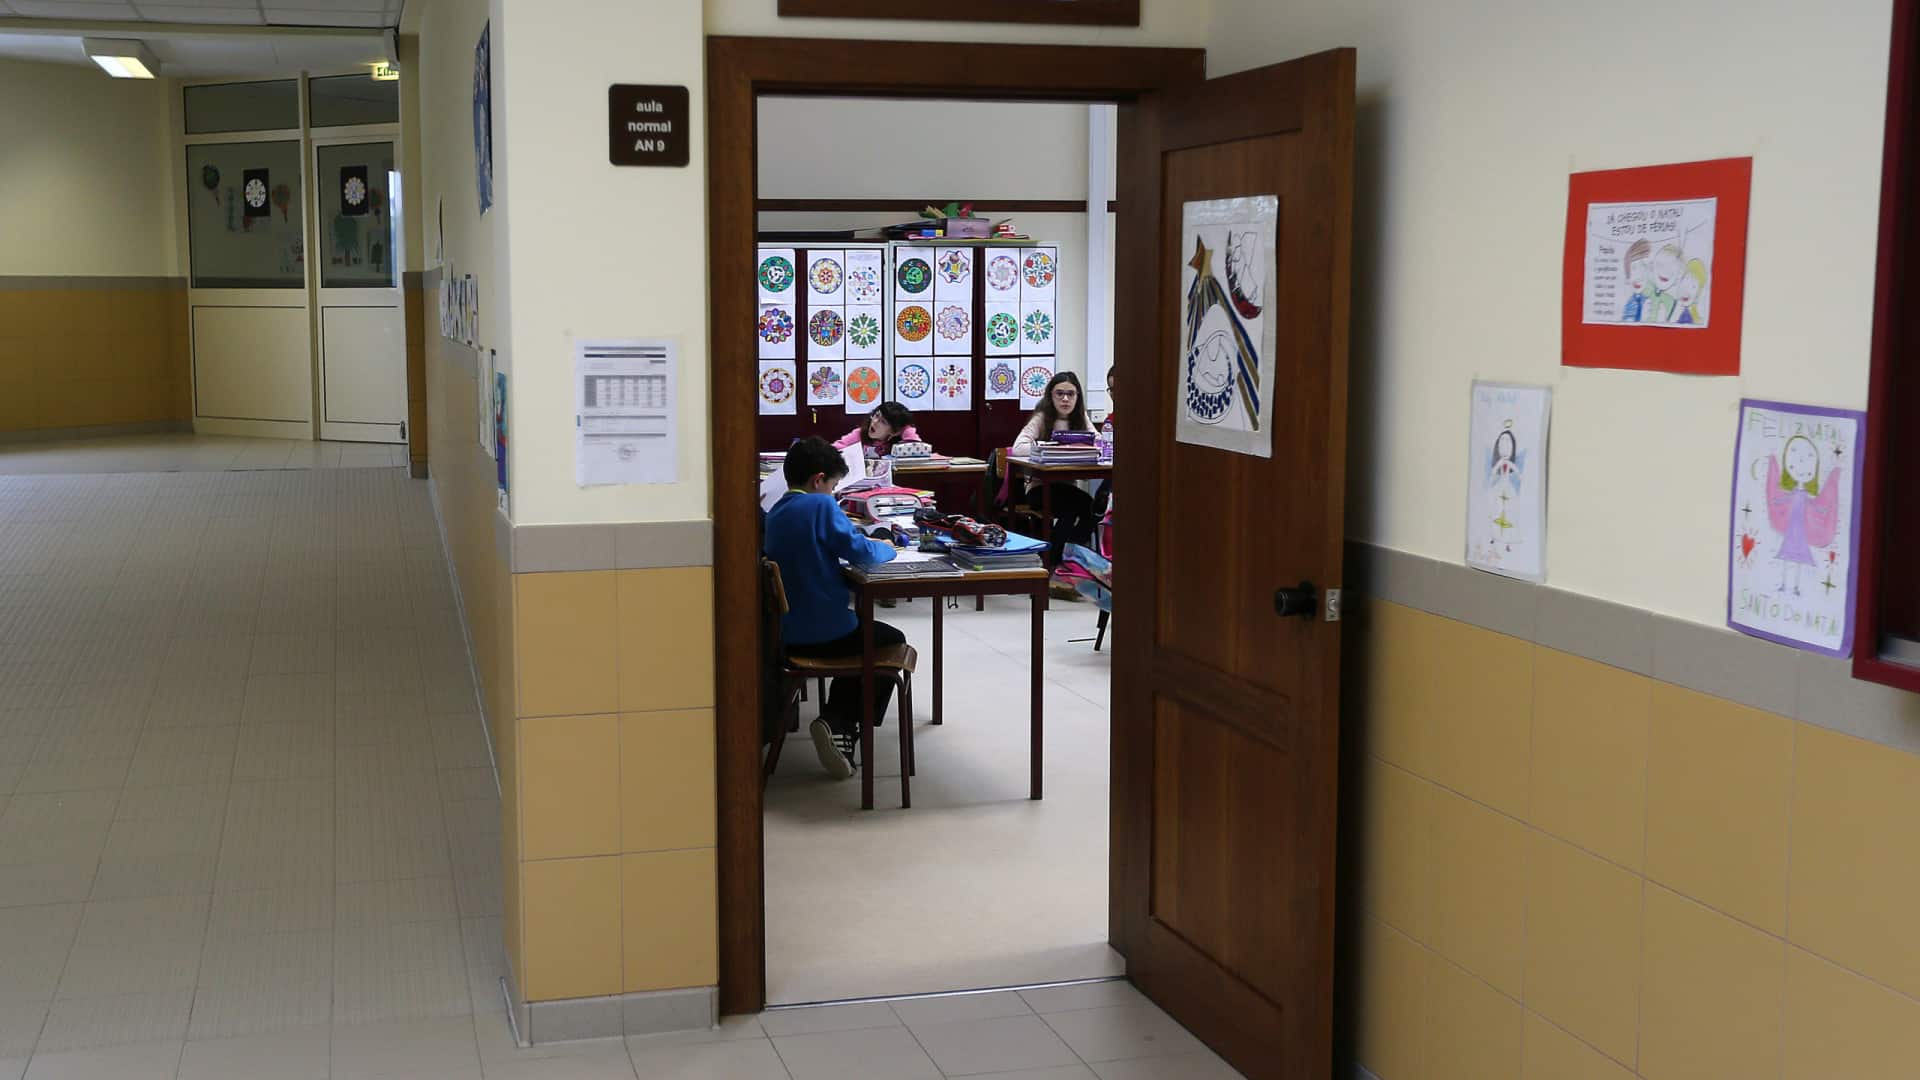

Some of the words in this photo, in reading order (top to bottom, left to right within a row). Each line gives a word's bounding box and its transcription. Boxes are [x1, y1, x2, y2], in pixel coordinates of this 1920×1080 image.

[636, 99, 663, 112] aula
[627, 120, 672, 132] normal
[634, 138, 654, 152] AN
